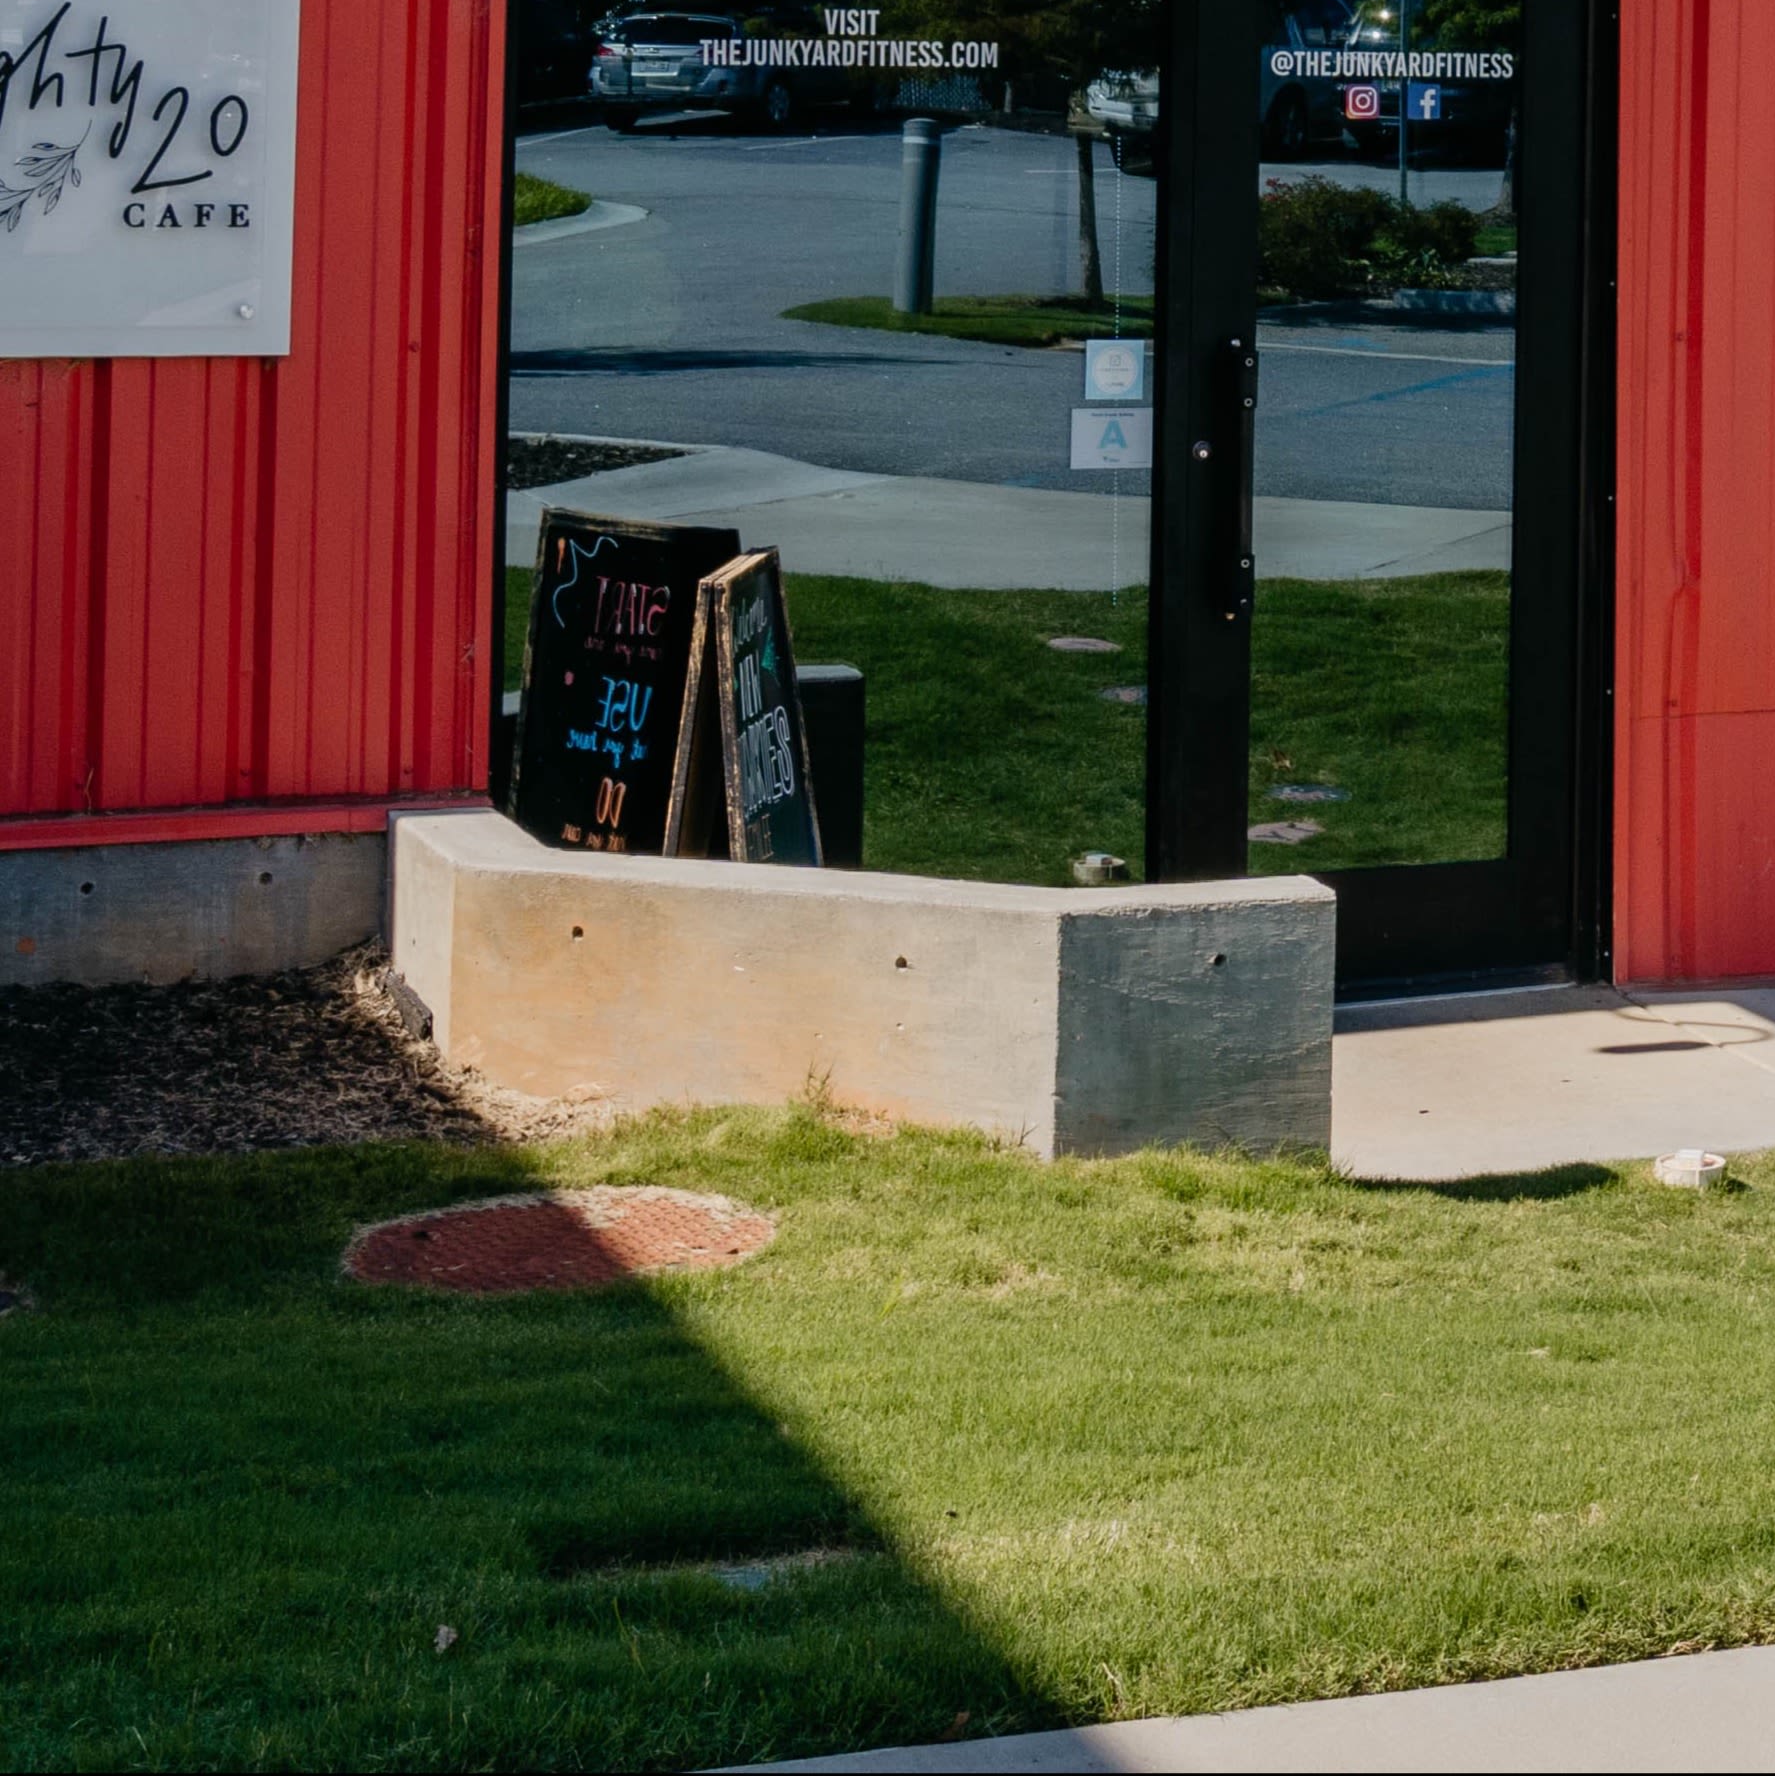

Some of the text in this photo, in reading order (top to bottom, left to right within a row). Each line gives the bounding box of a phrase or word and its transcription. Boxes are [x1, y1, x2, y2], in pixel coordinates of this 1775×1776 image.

[824, 9, 880, 36] VISIT
[699, 38, 999, 68] THEJUNKYARDFITNESS.COM
[1270, 51, 1514, 79] @THEJUNKYARDFITNESS
[122, 203, 251, 229] CAFE
[1098, 419, 1128, 449] A
